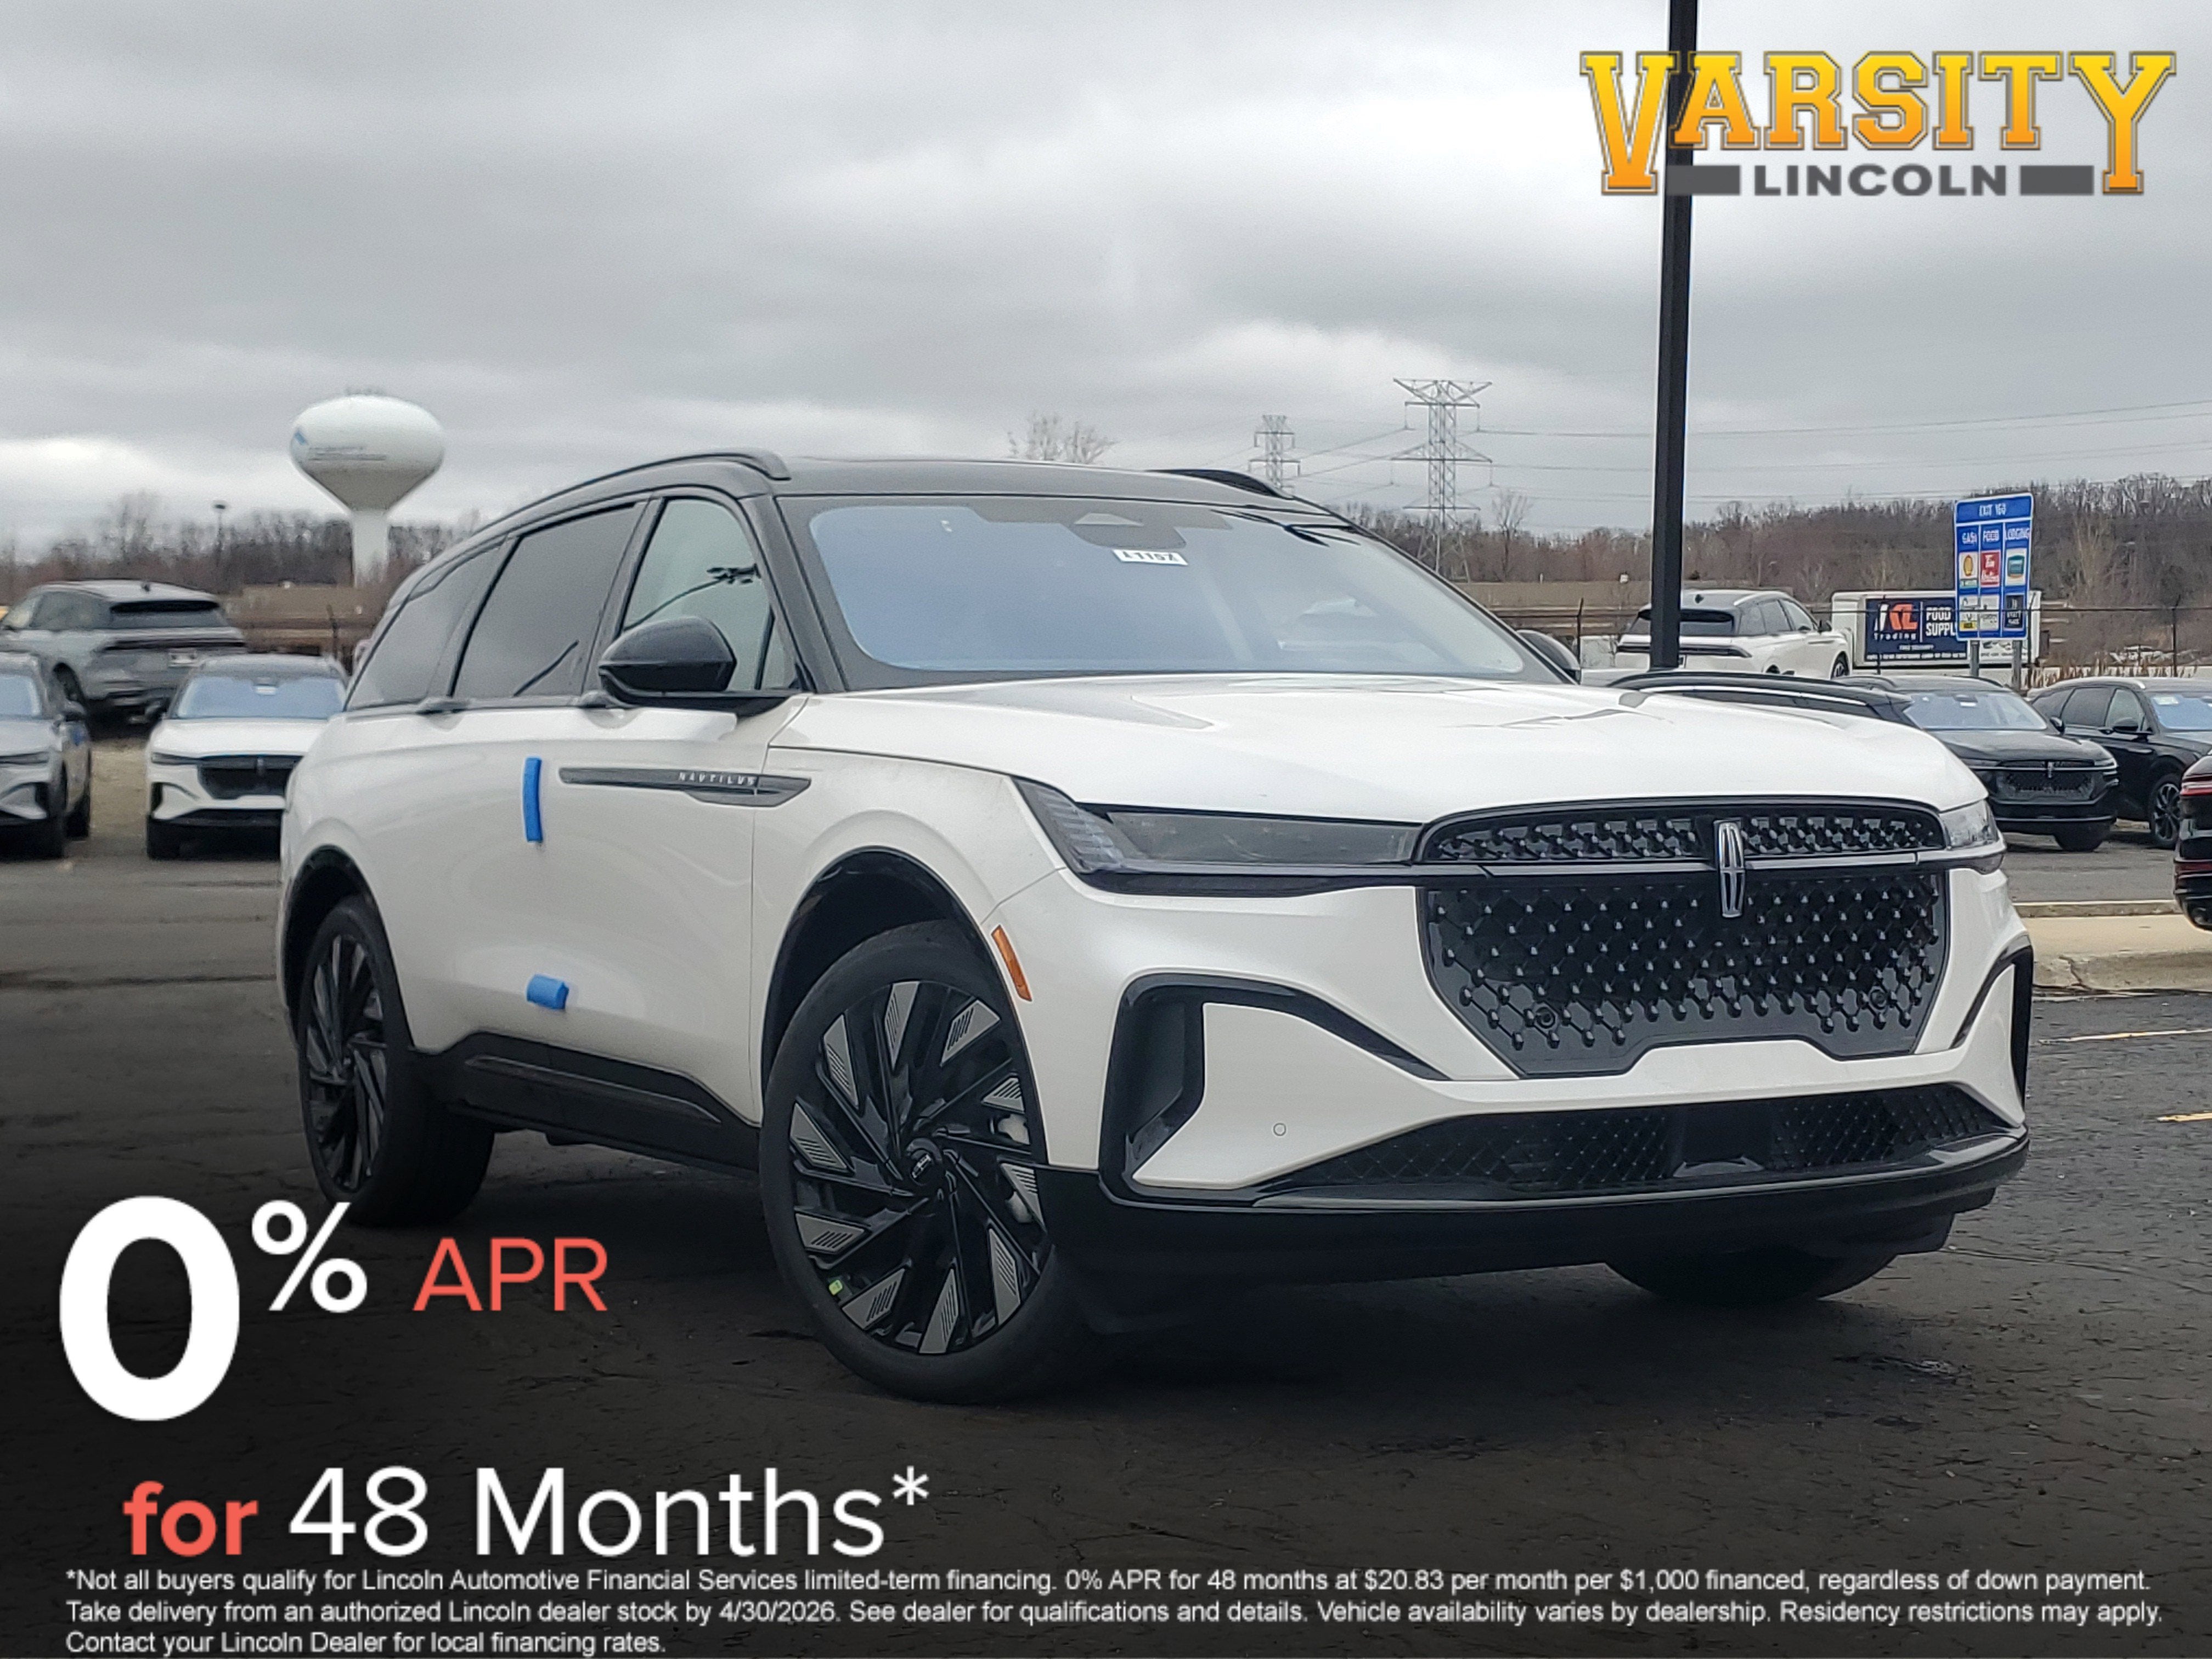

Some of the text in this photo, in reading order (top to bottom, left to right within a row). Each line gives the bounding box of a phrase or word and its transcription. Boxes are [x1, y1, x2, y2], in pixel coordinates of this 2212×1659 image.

[1926, 607, 1951, 621] FOOD
[1926, 622, 1956, 636] SUPPL
[679, 771, 756, 786] NAUTILUS
